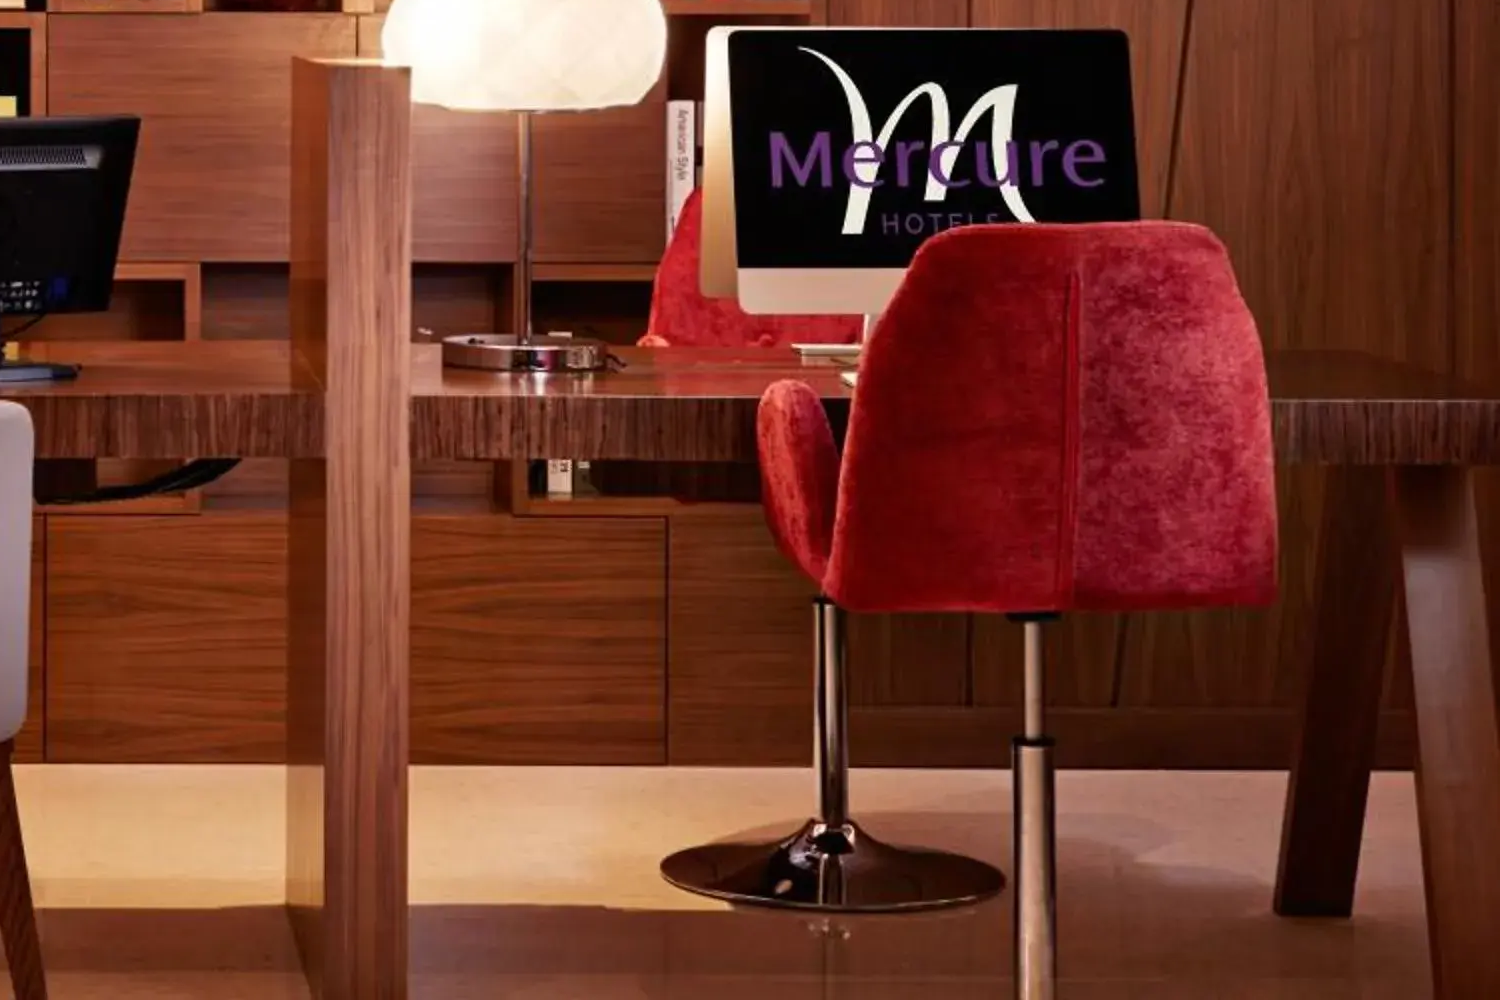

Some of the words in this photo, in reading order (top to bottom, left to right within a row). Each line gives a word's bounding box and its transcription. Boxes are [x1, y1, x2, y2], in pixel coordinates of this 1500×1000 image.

[676, 109, 689, 155] American
[675, 156, 688, 181] Style
[768, 130, 1107, 191] Mercure
